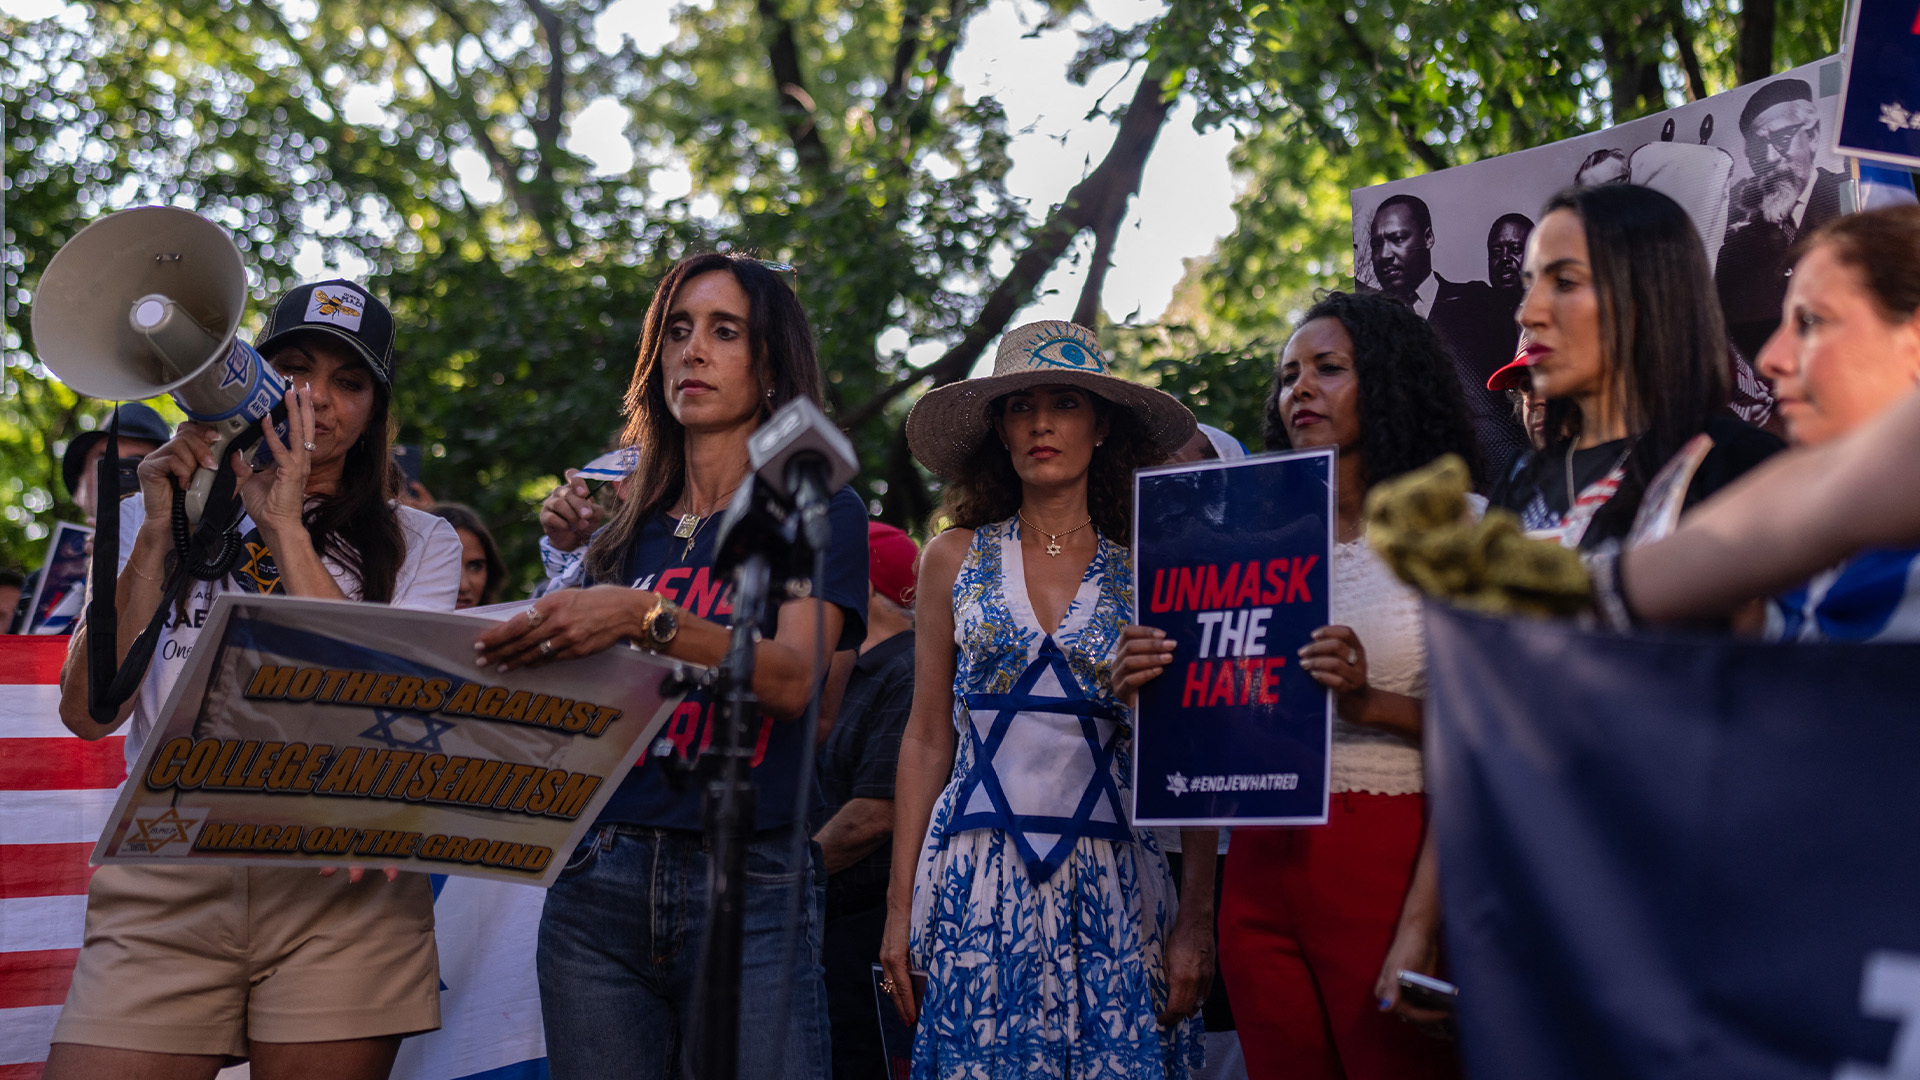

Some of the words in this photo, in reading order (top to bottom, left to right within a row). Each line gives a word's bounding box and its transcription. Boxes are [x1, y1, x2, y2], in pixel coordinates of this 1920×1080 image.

[258, 392, 269, 407] END
[1151, 556, 1319, 612] UNMASK
[1197, 607, 1273, 658] THE
[244, 664, 452, 710] MOTHERS
[447, 681, 624, 737] AGAINST
[1182, 656, 1286, 708] HATE
[146, 735, 331, 796] COLLEGE
[312, 743, 603, 820] ANTISEMITISM
[1190, 774, 1299, 793] #ENDJEWHATRED
[195, 822, 299, 853] MACA
[301, 828, 351, 854] ON
[354, 830, 421, 857] THE
[418, 834, 554, 871] GROUND
